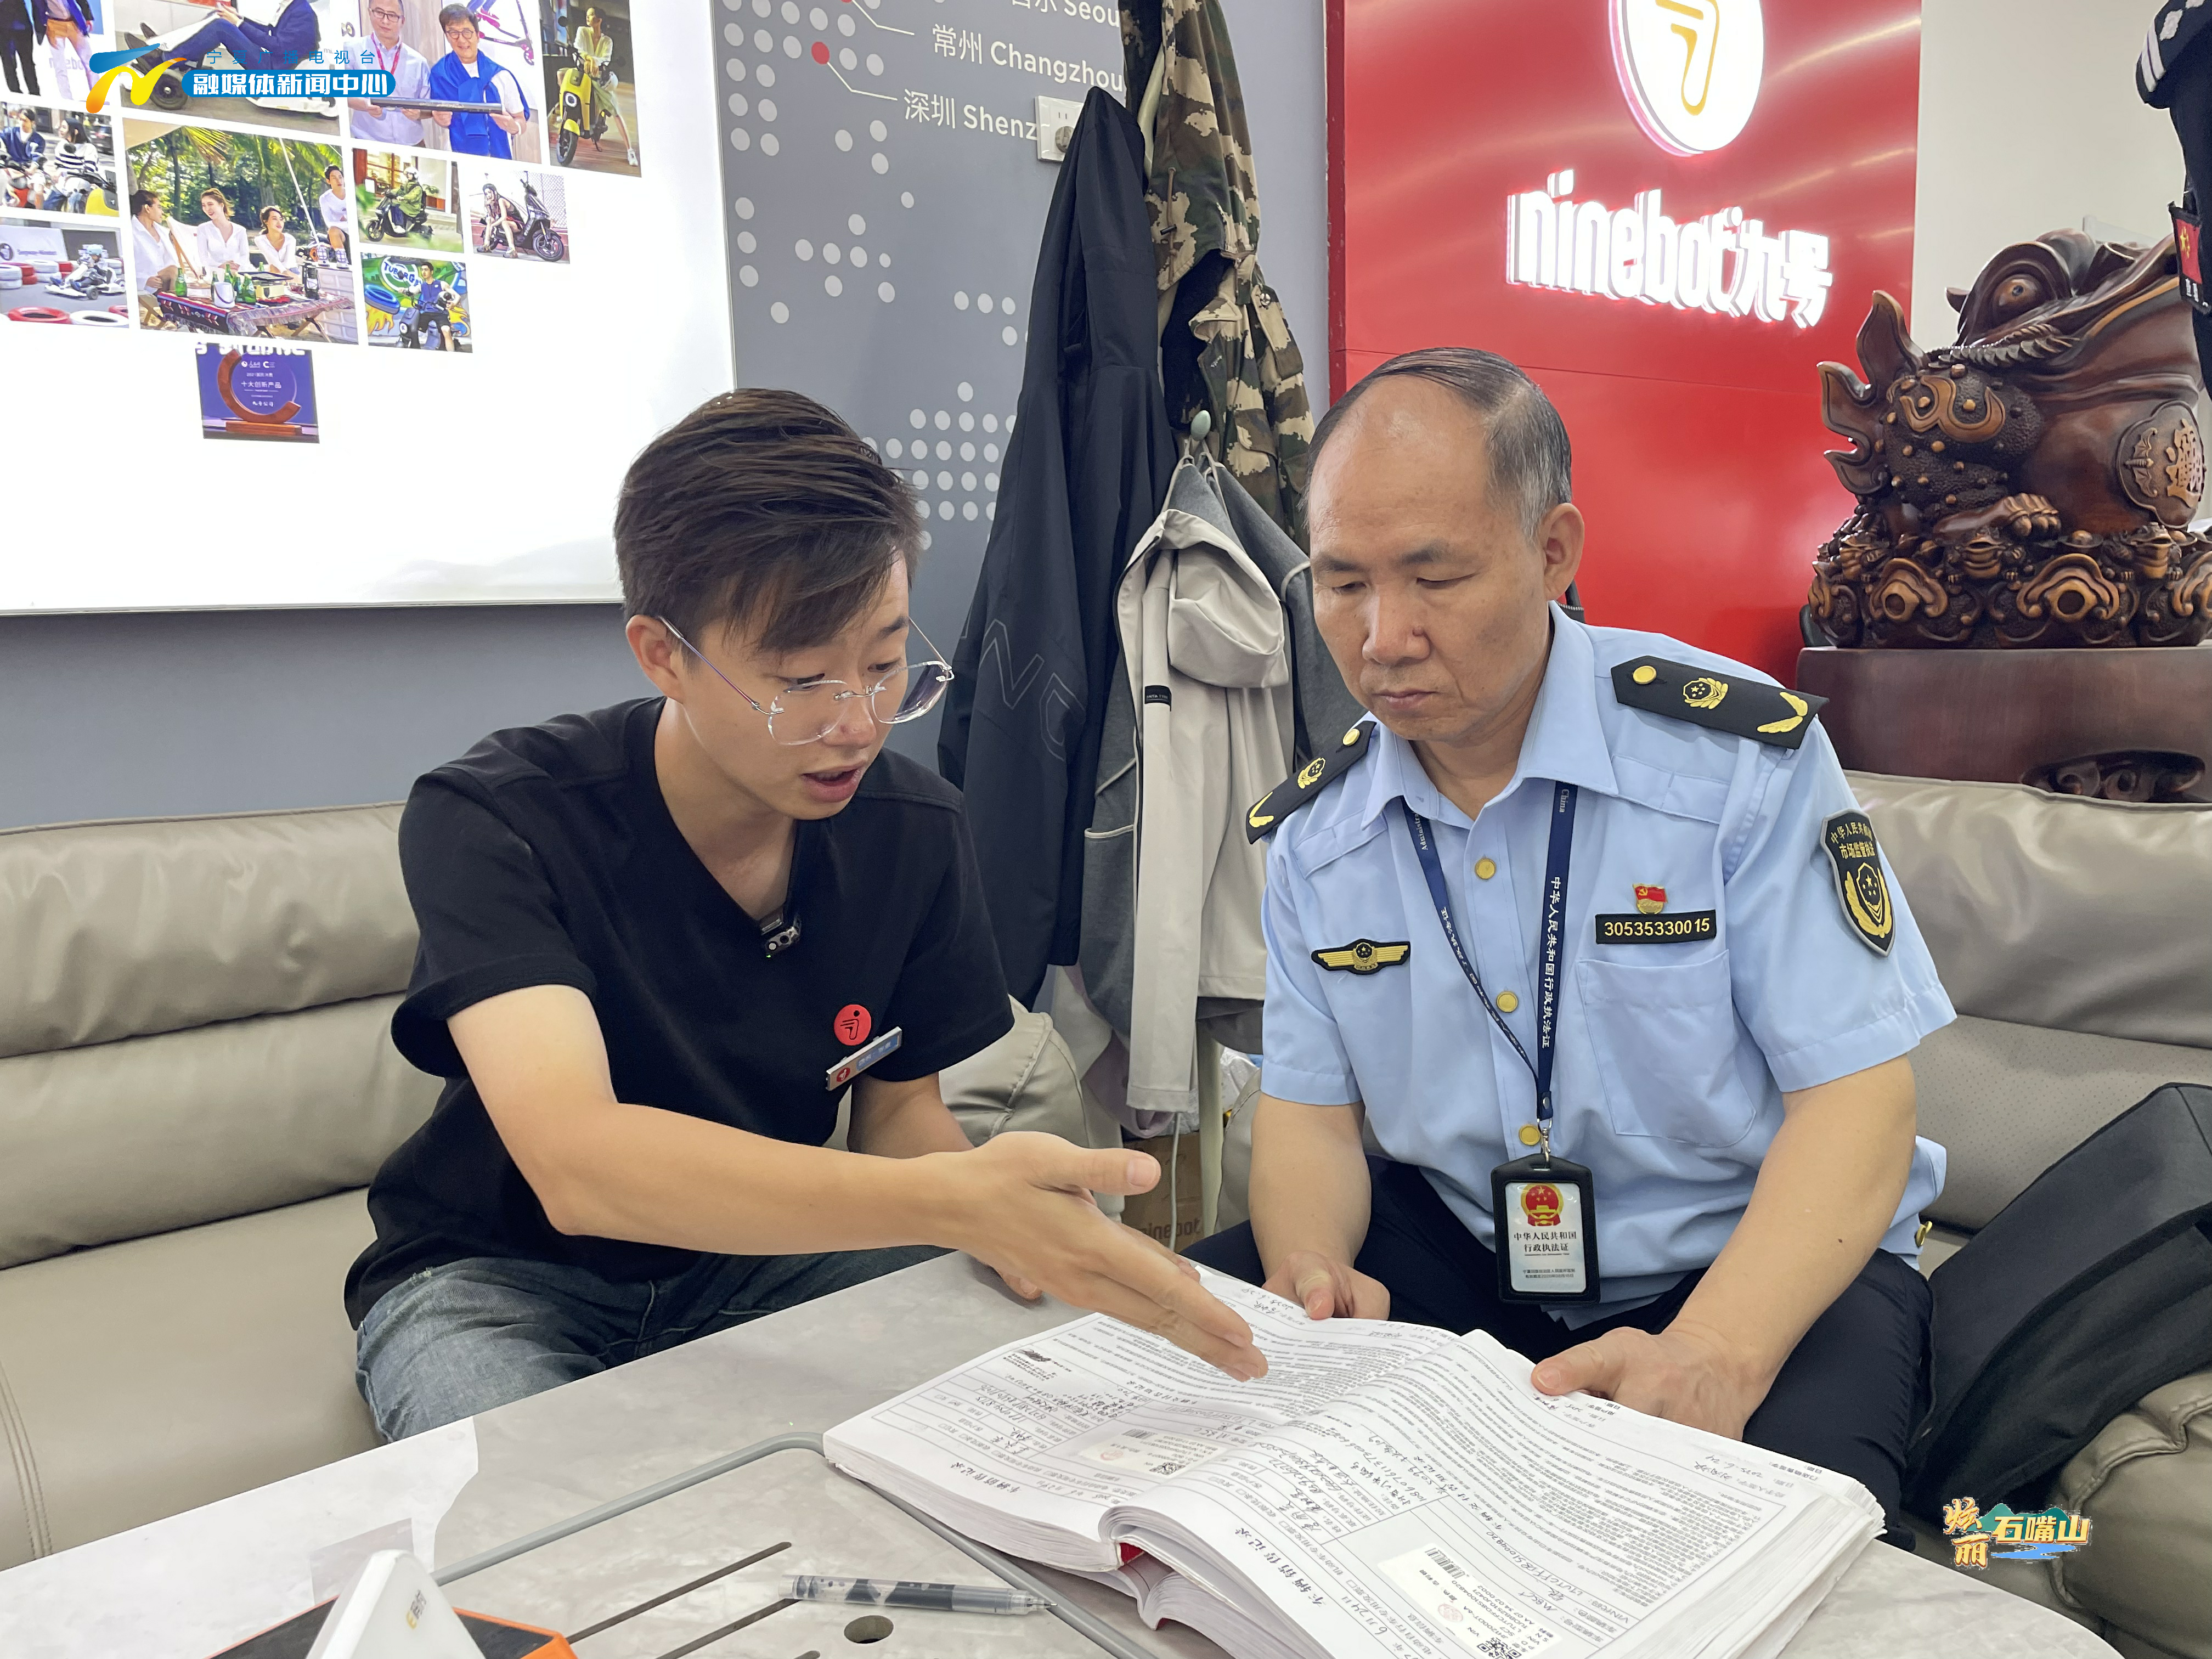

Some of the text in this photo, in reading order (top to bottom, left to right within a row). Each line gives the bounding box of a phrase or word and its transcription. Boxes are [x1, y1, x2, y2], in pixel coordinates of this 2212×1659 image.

[1063, 0, 1121, 27] Seou
[933, 24, 1124, 92] 常州 Changzhou
[904, 88, 1038, 141] 深圳 Shenz
[384, 261, 415, 283] TUBRG
[1413, 811, 1429, 851] Administra
[1604, 917, 1711, 937] 30535330015
[1541, 876, 1562, 1049] 中华人民共和国行政执法证
[1514, 1231, 1577, 1241] 中华人民共和国
[1523, 1243, 1570, 1253] 行政执法证
[1235, 1528, 1326, 1608] 车辆销售记录
[1467, 1627, 1480, 1637] VIN
